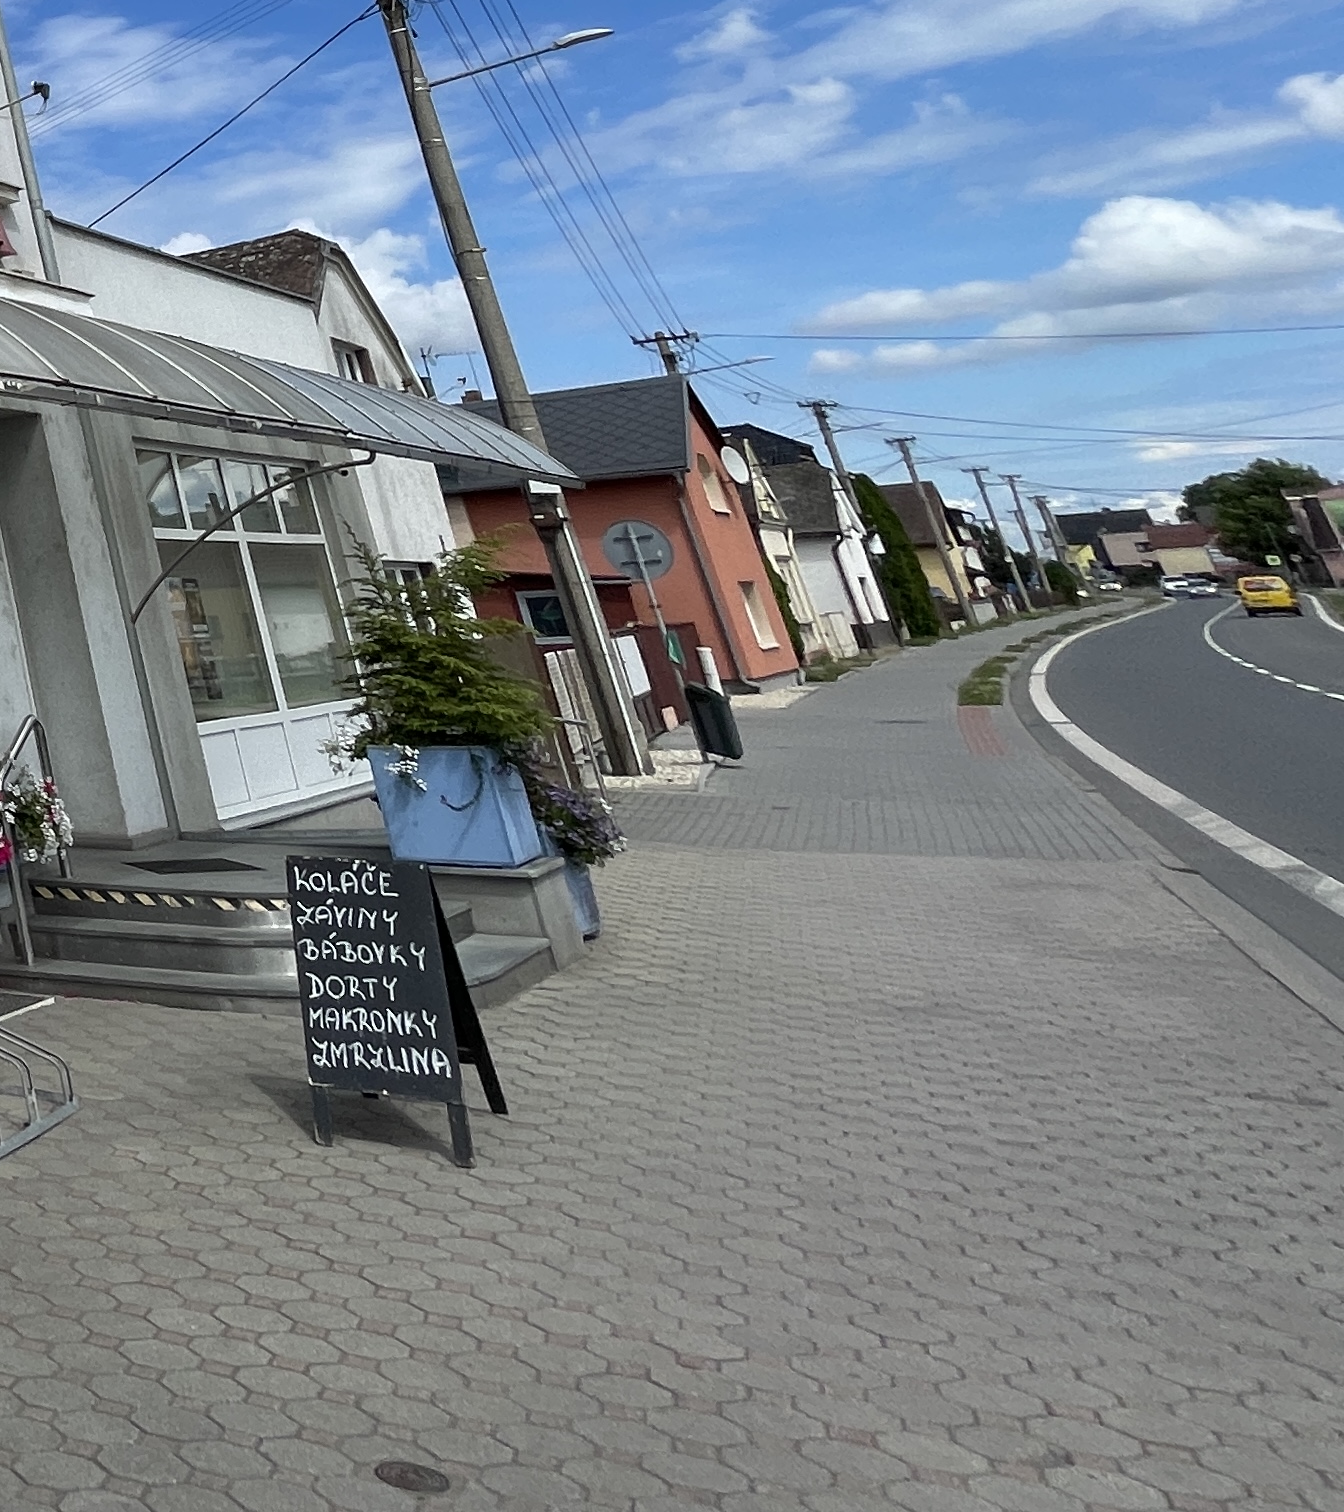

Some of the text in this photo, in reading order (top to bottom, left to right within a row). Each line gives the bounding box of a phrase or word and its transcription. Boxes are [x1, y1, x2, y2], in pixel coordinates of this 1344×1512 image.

[293, 861, 400, 897] KOLÁČE
[296, 898, 399, 937] ZÁVINY
[297, 932, 426, 972] BÁBOVKY
[305, 972, 398, 1002] DORTY
[309, 1006, 438, 1039] MAKRONKY
[311, 1036, 452, 1079] ZMRZLINA
